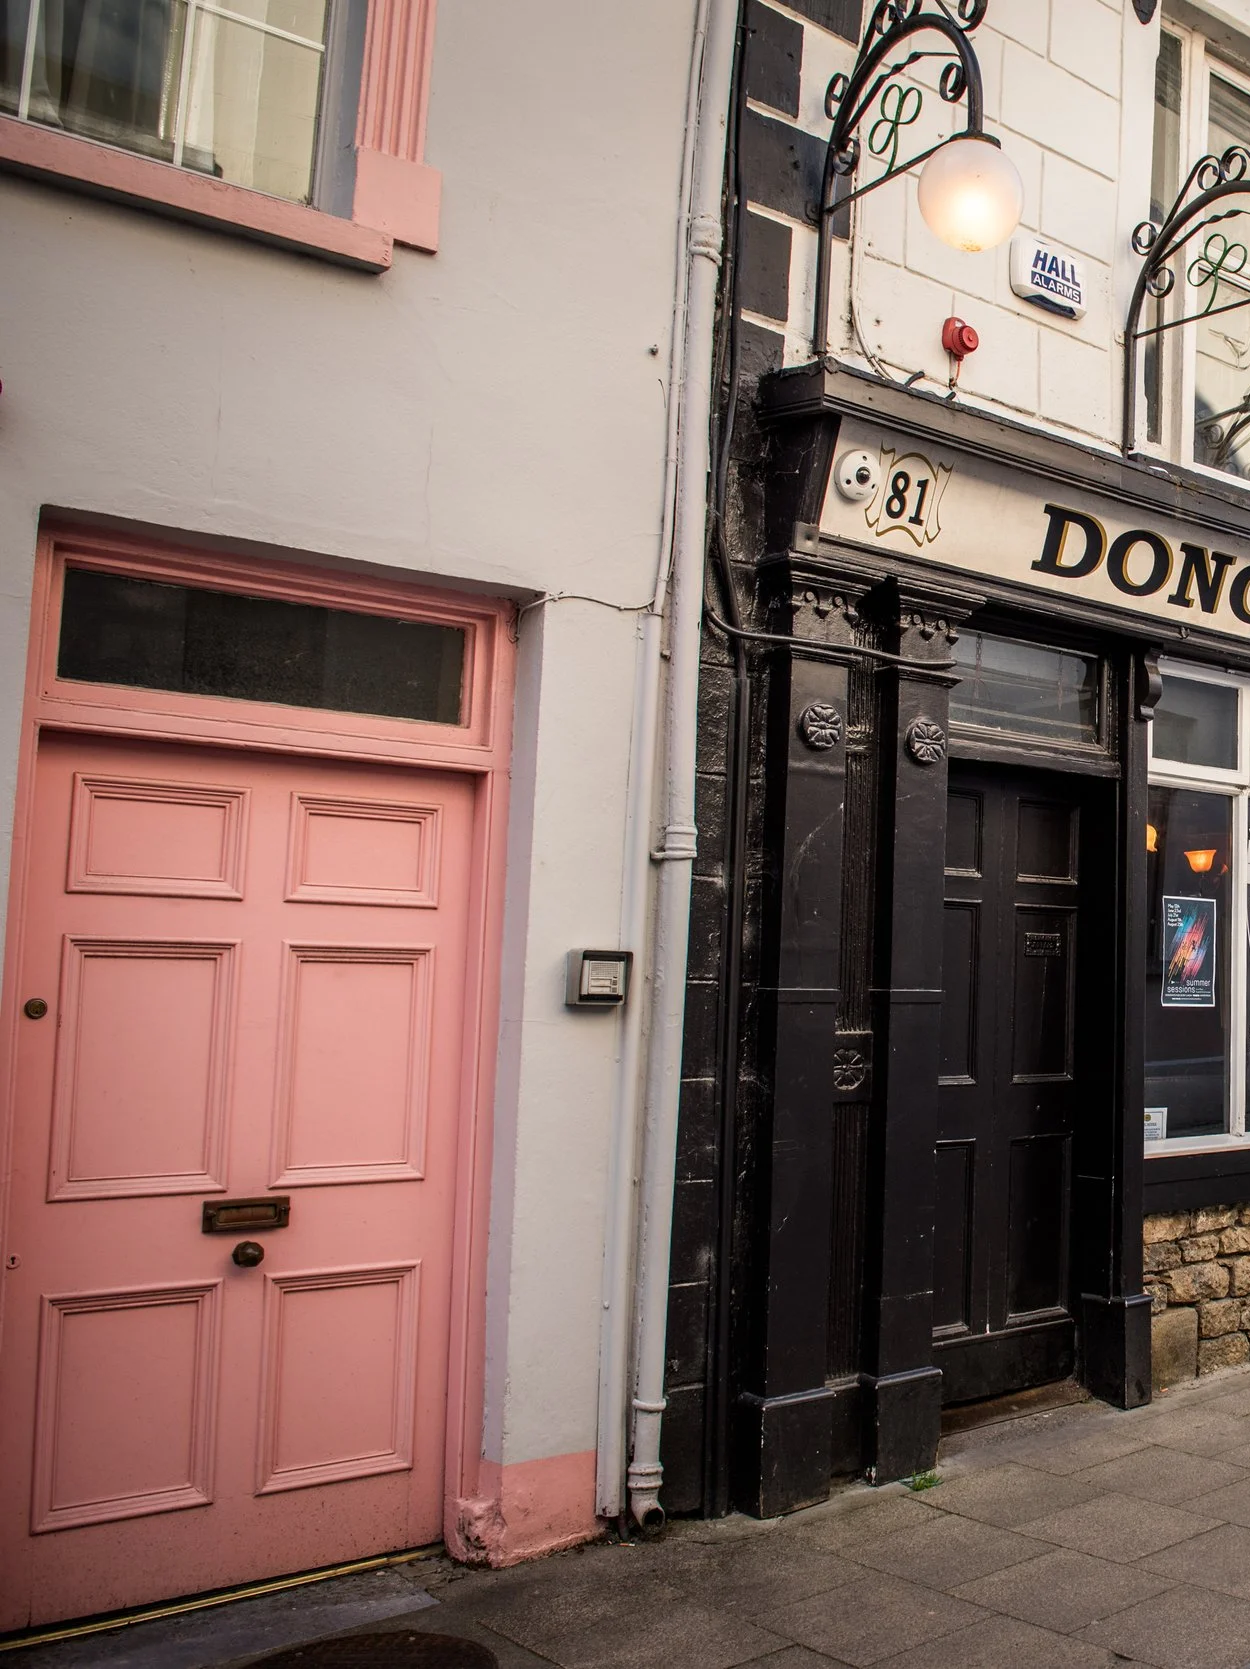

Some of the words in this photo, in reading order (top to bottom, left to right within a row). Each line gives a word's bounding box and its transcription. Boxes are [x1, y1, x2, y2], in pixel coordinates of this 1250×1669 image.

[1032, 249, 1081, 288] HALL
[1033, 273, 1080, 302] ALARMS
[885, 470, 929, 526] 81
[1167, 985, 1196, 994] sessions
[1186, 979, 1211, 987] summer
